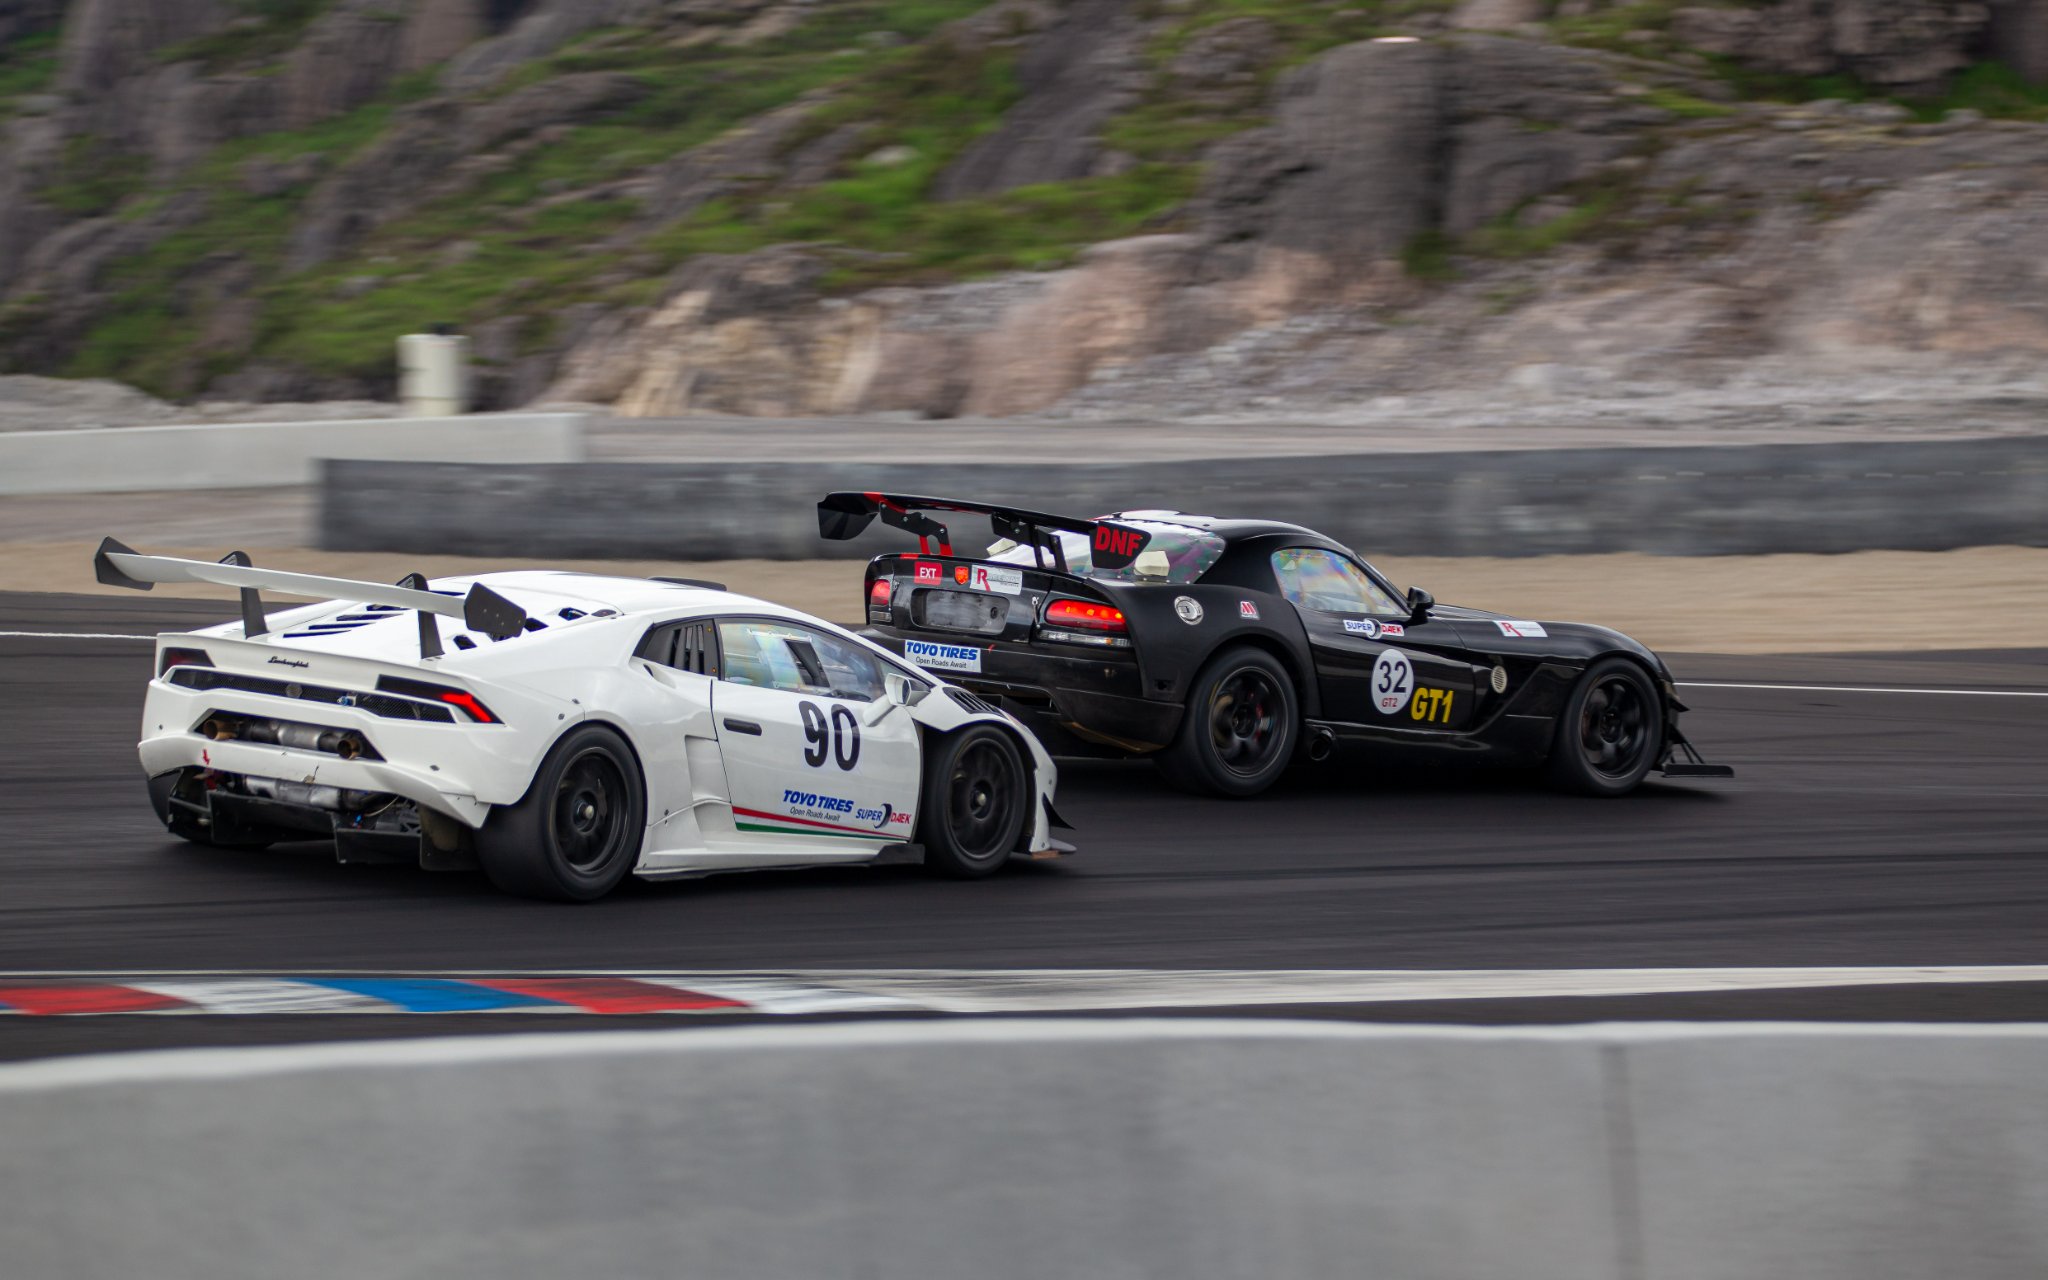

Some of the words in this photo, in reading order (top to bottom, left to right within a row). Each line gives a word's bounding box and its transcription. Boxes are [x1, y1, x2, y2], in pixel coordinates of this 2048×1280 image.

[1095, 526, 1143, 557] DNF
[920, 567, 936, 579] EXT
[1346, 621, 1372, 631] SUPER
[906, 641, 938, 656] TOYO
[940, 646, 978, 661] TIRES
[915, 656, 930, 664] Open
[931, 658, 949, 667] Roads
[950, 661, 967, 669] Await
[1378, 660, 1407, 693] 32
[1381, 697, 1398, 708] GT2
[1411, 687, 1454, 723] GT1
[798, 700, 861, 772] 90
[783, 789, 817, 807] TOYO
[817, 795, 854, 813] TIRES
[789, 806, 805, 815] Open
[805, 808, 824, 819] Roads
[824, 812, 840, 822] Await
[855, 808, 883, 821] SUPER
